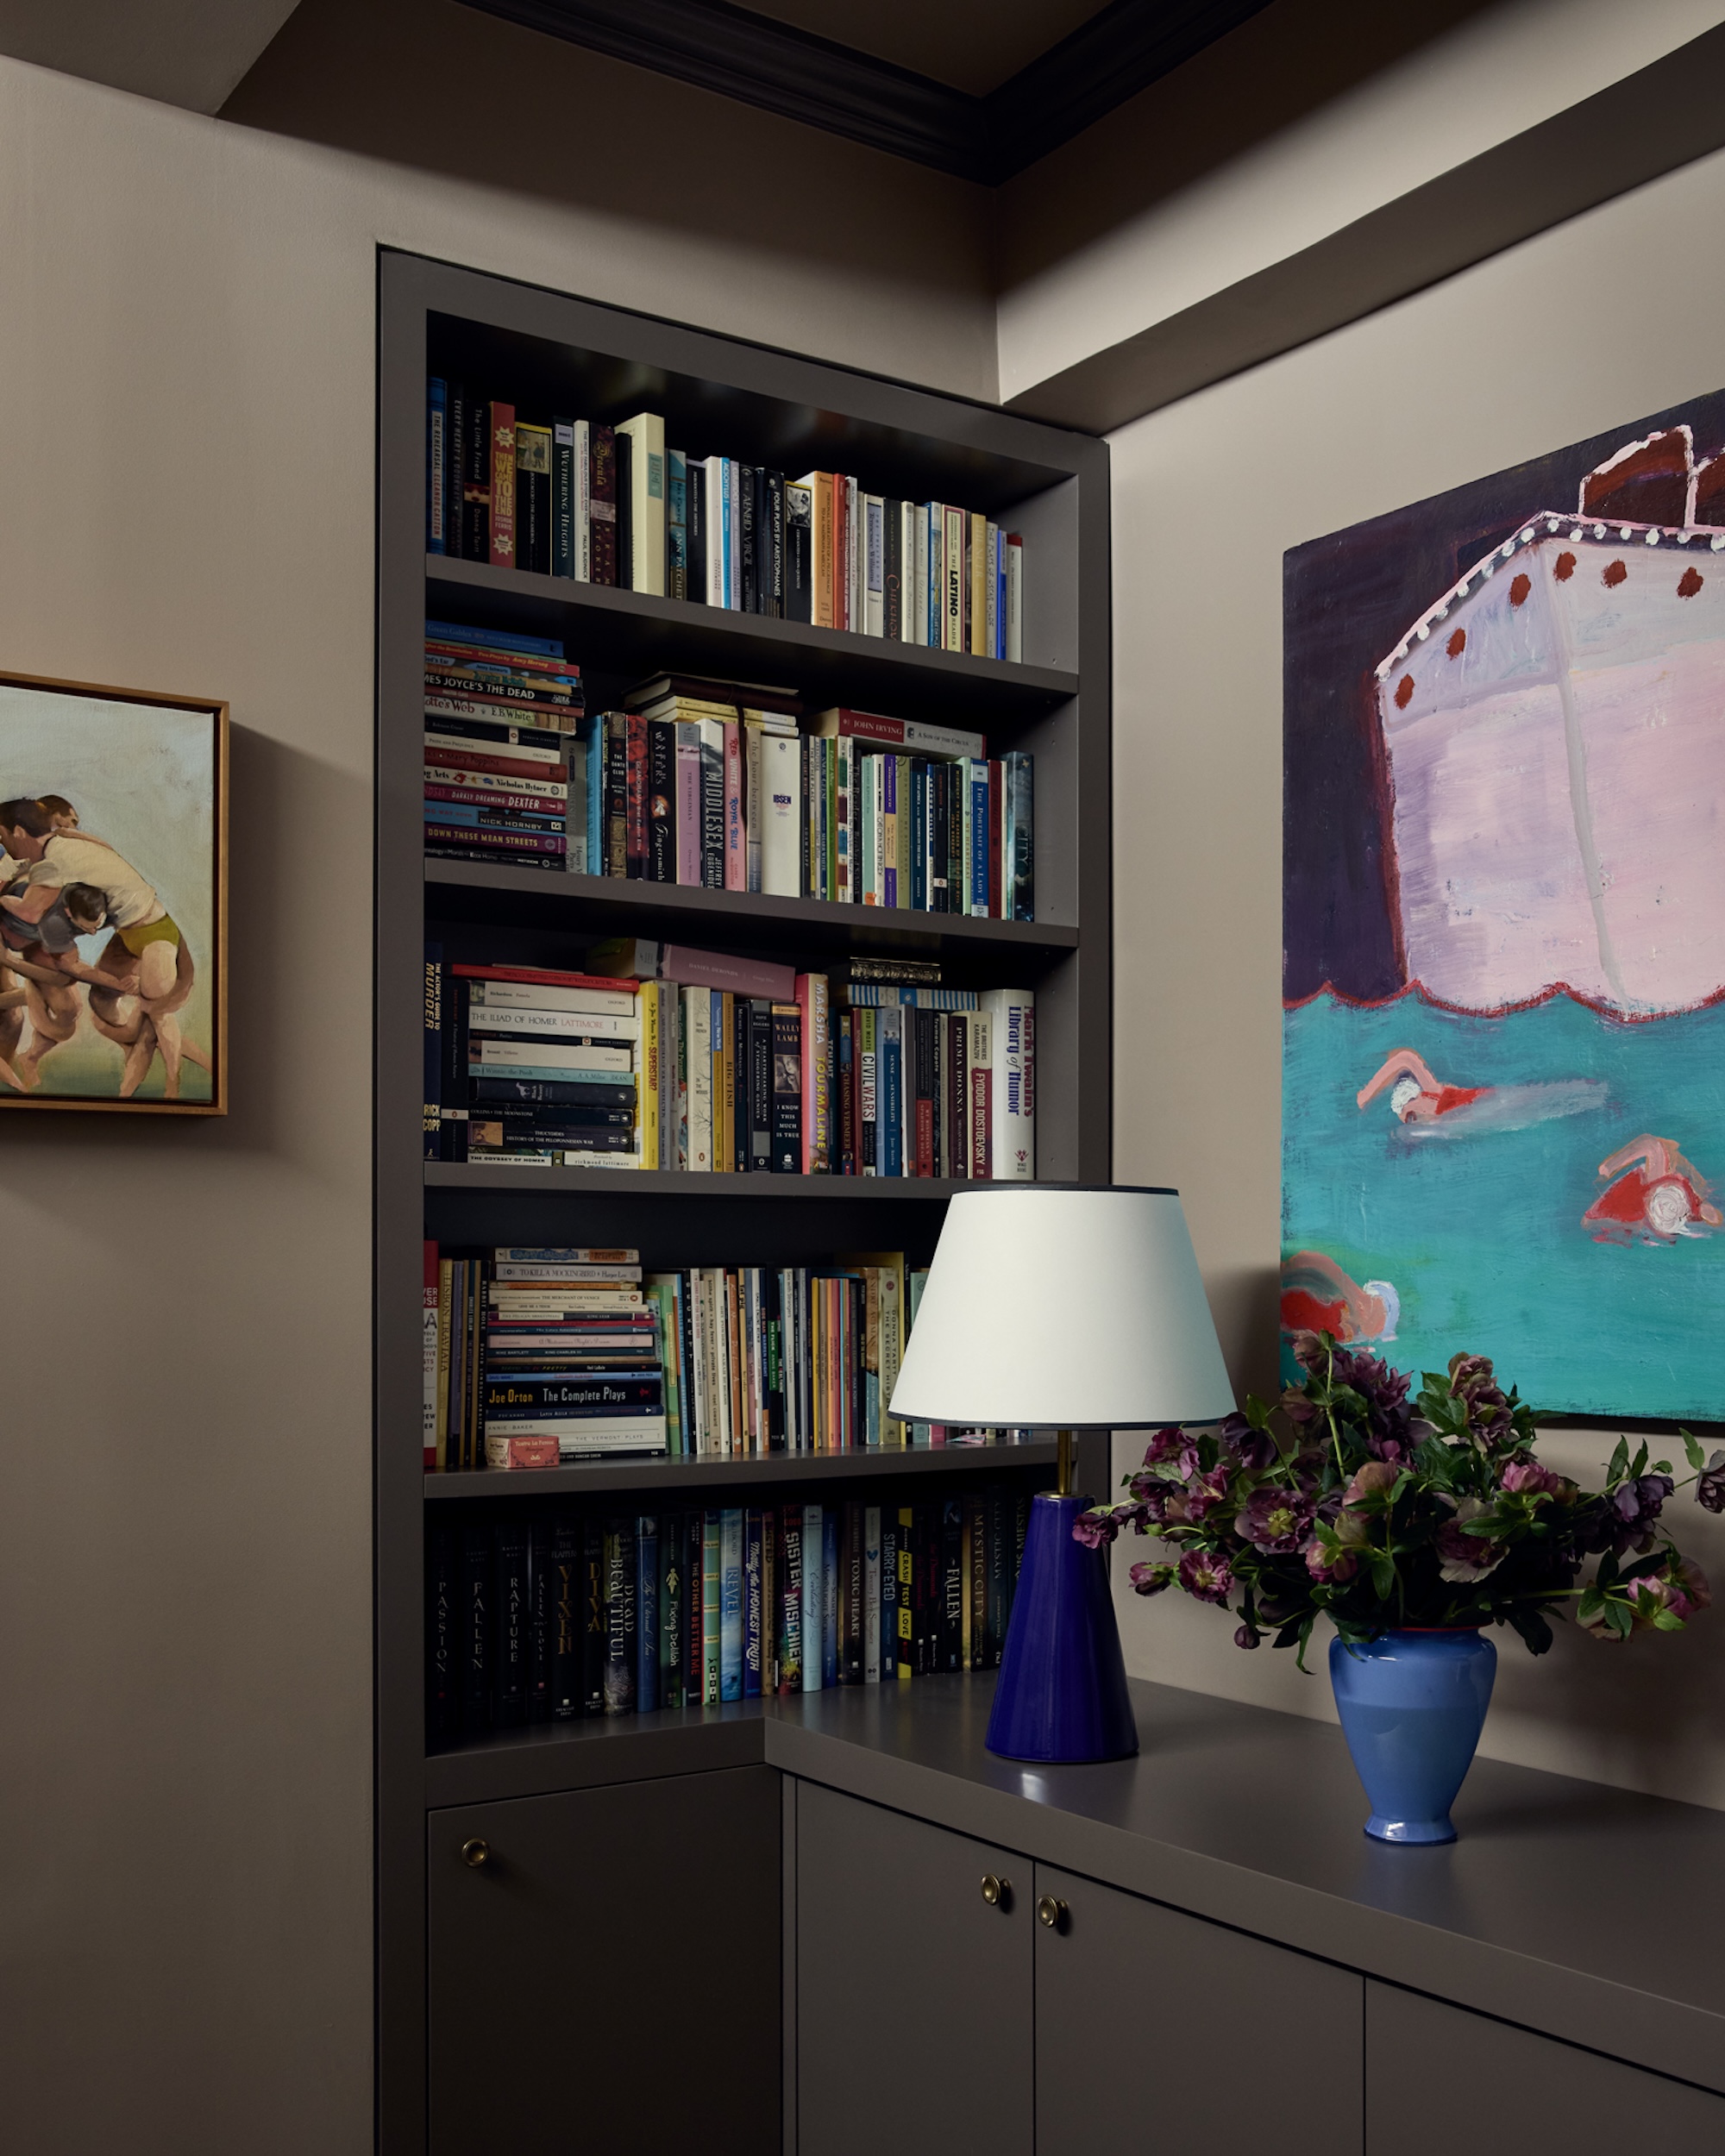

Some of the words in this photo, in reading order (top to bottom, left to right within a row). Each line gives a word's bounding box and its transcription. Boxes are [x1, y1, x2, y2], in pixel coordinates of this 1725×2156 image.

[433, 415, 442, 428] THE
[473, 409, 482, 423] The
[433, 430, 442, 471] REHEARSAL
[473, 427, 482, 448] Little
[473, 452, 482, 479] Friend
[495, 451, 513, 461] THEN
[495, 460, 513, 475] WE
[593, 441, 611, 486] Dracula
[433, 473, 442, 506] ELEANOR
[495, 480, 512, 498] TO
[560, 449, 570, 511] WUTHERING
[495, 495, 512, 507] THE
[495, 505, 512, 517] END
[743, 493, 753, 531] AENEID
[773, 492, 781, 511] FOUR
[433, 509, 442, 536] CATTON
[473, 509, 482, 532] Donna
[560, 513, 570, 559] HEIGHTS
[773, 512, 781, 533] PLAYS
[743, 536, 753, 567] VIRGIL
[773, 533, 781, 544] BY
[773, 545, 781, 597] ARISTOPHANES
[987, 568, 994, 578] OF
[950, 569, 958, 617] LATINO
[443, 677, 483, 692] JOYCE'S
[487, 684, 505, 694] THE
[507, 686, 536, 699] DEAD
[424, 696, 450, 709] otte's
[453, 699, 475, 714] Web
[854, 719, 874, 730] JOHN
[875, 723, 903, 736] IRVING
[446, 752, 467, 767] Mary
[470, 755, 500, 769] Poppins
[729, 737, 738, 755] RED
[434, 769, 449, 779] Arts
[496, 779, 524, 789] Nicholas
[525, 783, 548, 793] Hytner
[976, 787, 985, 803] THE
[451, 791, 474, 801] DARKLY
[475, 793, 506, 805] DREAMING
[508, 796, 541, 810] DEXTER
[706, 772, 724, 850] MIDDLESEX
[729, 797, 738, 825] ROYAL
[428, 828, 452, 837] DOWN
[455, 830, 479, 841] THESE
[480, 833, 503, 844] MEAN
[505, 836, 539, 848] STREETS
[506, 822, 543, 830] HORNBY
[729, 827, 738, 850] BLUE
[976, 806, 985, 848] PORTRAIT
[654, 823, 668, 881] Fingersmith
[976, 850, 985, 861] OF
[706, 852, 715, 889] EUGENIDES
[714, 857, 723, 887] JEFFREY
[976, 872, 985, 894] LADY
[424, 962, 435, 1031] MURDER
[435, 1021, 442, 1031] TO
[490, 1014, 512, 1024] ILIAD
[514, 1015, 525, 1024] OF
[528, 1016, 558, 1026] HOMER
[560, 1018, 605, 1031] LATTIMORE
[815, 983, 825, 1045] MARSHA
[1007, 1006, 1021, 1053] Library
[1024, 1006, 1034, 1054] Mark
[1007, 1056, 1021, 1073] of
[815, 1056, 826, 1150] TOURMALINE
[843, 1074, 851, 1109] CHASING
[975, 1073, 985, 1106] FYODOR
[1007, 1071, 1021, 1116] Humor
[1024, 1055, 1034, 1118] Twain's
[843, 1110, 851, 1150] VERMEER
[975, 1109, 985, 1165] DOSTOEVSKY
[441, 1277, 451, 1318] LISBON
[441, 1320, 451, 1373] TRAVIATA
[488, 1388, 506, 1403] Joe
[507, 1388, 534, 1403] Orton
[543, 1388, 558, 1402] The
[561, 1384, 601, 1403] Complete
[603, 1382, 626, 1402] Plays
[784, 1531, 802, 1590] SISTER
[974, 1514, 985, 1576] MYSTIC
[691, 1562, 699, 1577] THE
[850, 1557, 861, 1595] TOXIC
[882, 1532, 896, 1602] STARRY-EYED
[901, 1553, 910, 1583] CRASH
[624, 1584, 634, 1633] DEAD
[691, 1579, 699, 1613] OTHER
[726, 1567, 740, 1618] REVEL
[806, 1571, 821, 1620] Everlasting
[901, 1586, 910, 1607] TEST
[944, 1568, 961, 1620] FALLEN
[974, 1579, 985, 1619] CITY
[471, 1582, 486, 1670] FALLEN
[509, 1576, 522, 1664] RAPTURE
[609, 1557, 624, 1663] BEAUTIFUL
[664, 1601, 680, 1632] Fixing
[750, 1589, 760, 1636] HONEST
[850, 1596, 861, 1639] HEART
[901, 1613, 910, 1636] LOVE
[436, 1582, 449, 1673] PASSION
[691, 1615, 699, 1656] BETTER
[784, 1592, 802, 1666] MISCHIEF
[669, 1633, 680, 1667] Delilah
[746, 1636, 759, 1671] TRUTH
[691, 1658, 699, 1676] ME
